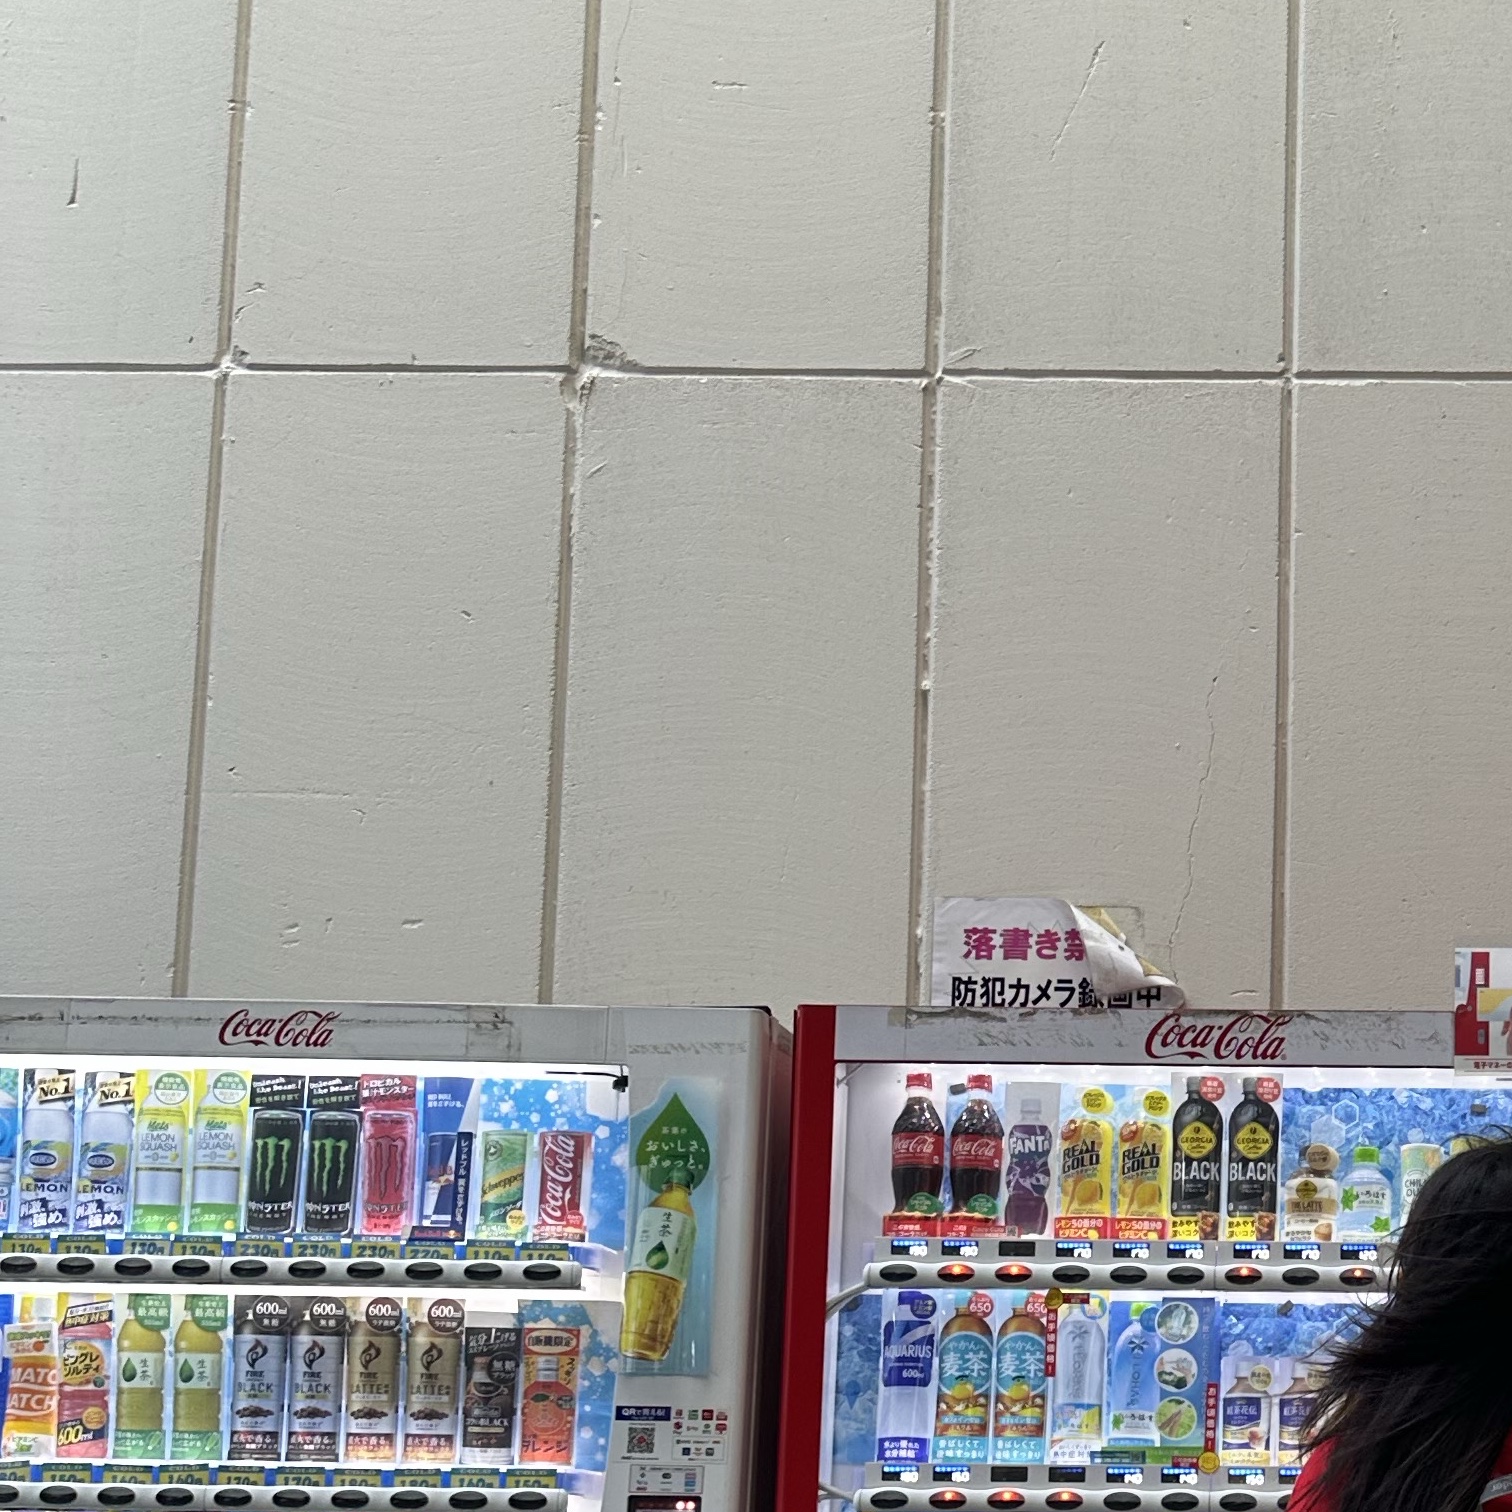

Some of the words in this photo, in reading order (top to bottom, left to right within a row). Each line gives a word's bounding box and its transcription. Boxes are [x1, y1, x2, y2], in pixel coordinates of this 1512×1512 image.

[219, 1008, 342, 1048] Coca-Cola
[1145, 1012, 1291, 1061] Coca-Cola
[1009, 1135, 1050, 1154] FANTA
[1063, 1139, 1099, 1159] REAL
[1236, 1137, 1270, 1145] GEORGIA
[649, 1156, 704, 1169] ぎゅっと。
[1122, 1142, 1160, 1164] REAL
[1062, 1155, 1100, 1173] GOLD
[1122, 1156, 1160, 1176] GOLD
[1173, 1161, 1220, 1182] BLACK
[1229, 1162, 1276, 1182] BLACK
[20, 1183, 68, 1193] LEMON
[659, 1212, 673, 1237] 生茶
[969, 1302, 991, 1314] 650
[884, 1345, 932, 1359] AQUARIUS
[139, 1358, 151, 1381] 生茶
[942, 1352, 991, 1377] 麦茶
[998, 1352, 1045, 1377] 麦茶
[237, 1383, 274, 1394] BLACK
[1226, 1404, 1257, 1416] 紅茶花伝
